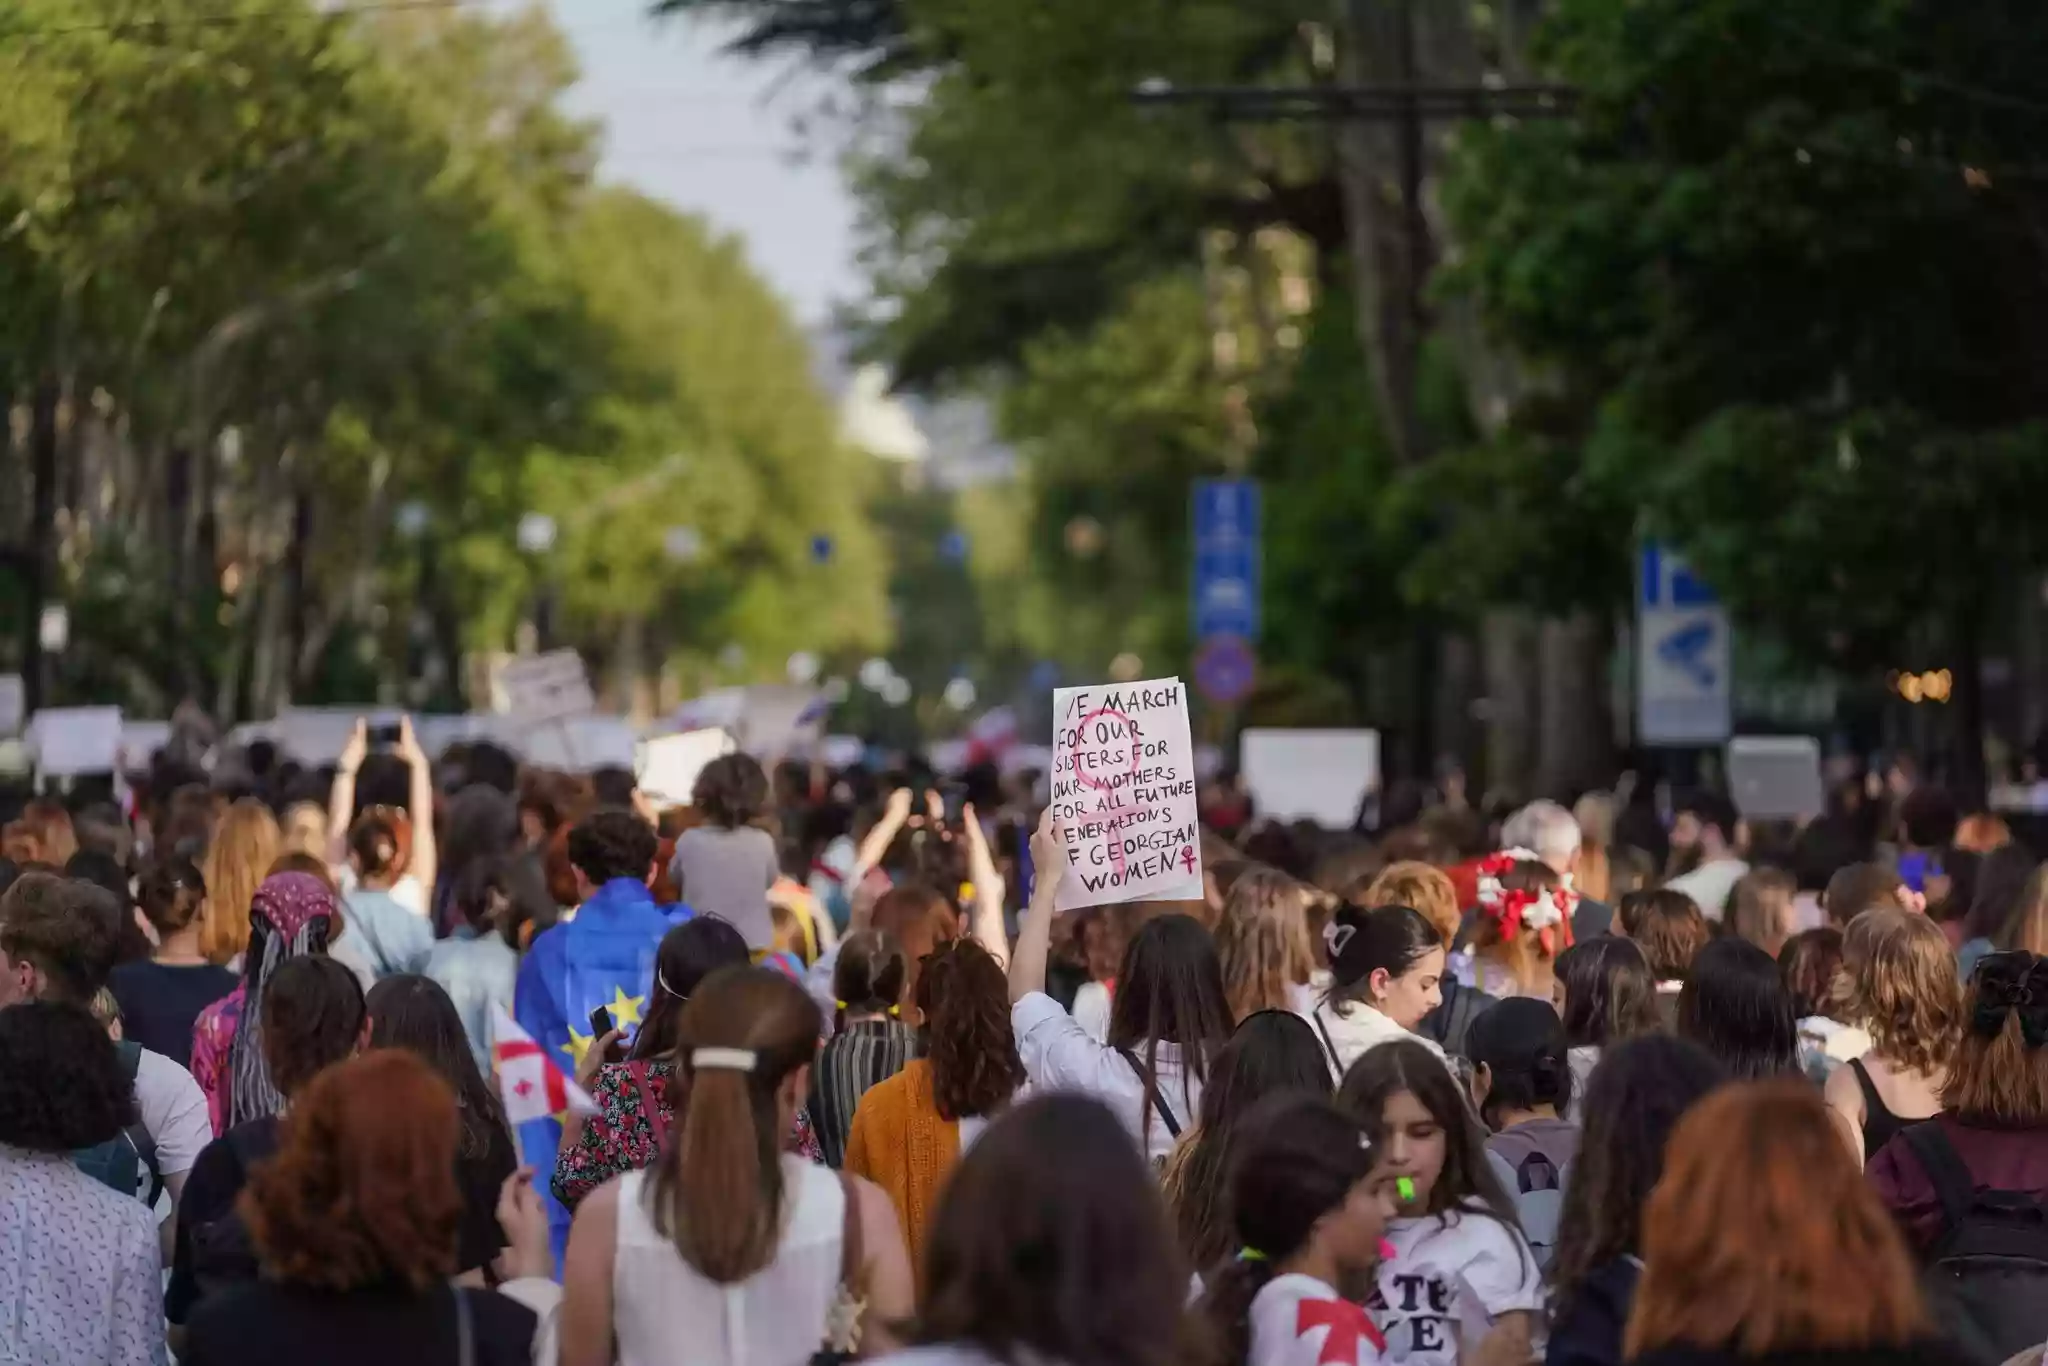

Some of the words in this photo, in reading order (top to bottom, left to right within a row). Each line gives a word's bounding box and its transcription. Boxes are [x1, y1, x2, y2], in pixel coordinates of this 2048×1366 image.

[1100, 687, 1178, 716] MARCH
[1058, 726, 1087, 750] FOR
[1096, 720, 1145, 744] OUR
[1131, 740, 1169, 760] FOR
[1054, 779, 1086, 799] OUR
[1094, 767, 1176, 790] MOTHERS
[1052, 801, 1087, 822] FOR
[1096, 795, 1126, 812] ALL
[1134, 780, 1193, 804] FUTURE
[1090, 820, 1196, 865] GEORGIAN
[1080, 848, 1177, 893] WOMEN
